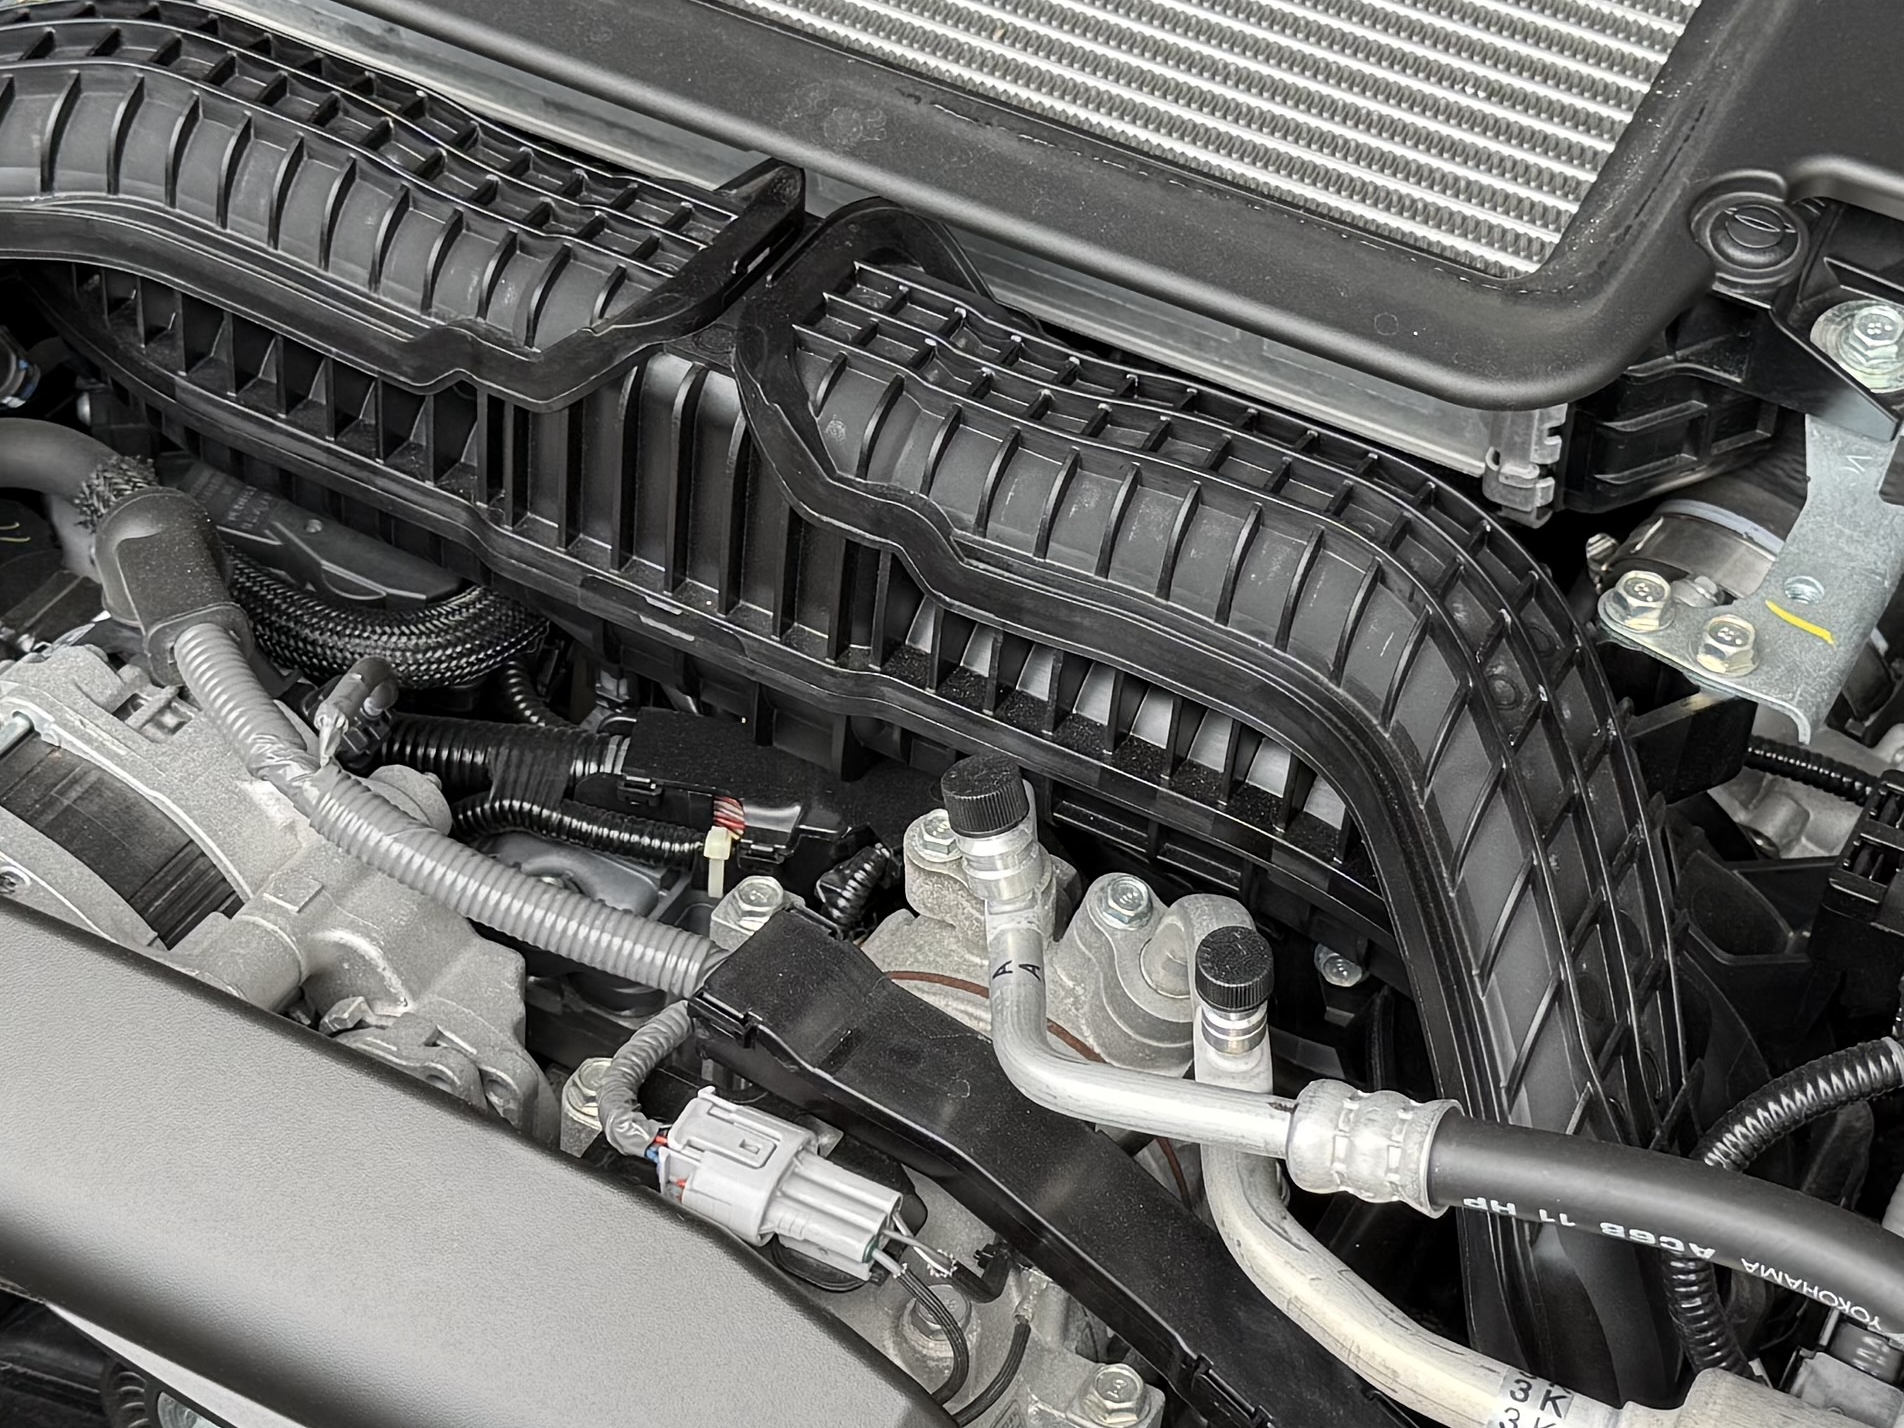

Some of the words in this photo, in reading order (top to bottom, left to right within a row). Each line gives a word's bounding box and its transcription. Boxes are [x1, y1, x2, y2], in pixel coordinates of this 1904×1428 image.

[1464, 1195, 1517, 1218] HP
[1537, 1207, 1577, 1228] 11
[1598, 1220, 1717, 1260] AC6B
[1739, 1257, 1883, 1332] YOKOHAMA
[1508, 1377, 1532, 1404] 3
[1537, 1387, 1568, 1419] K
